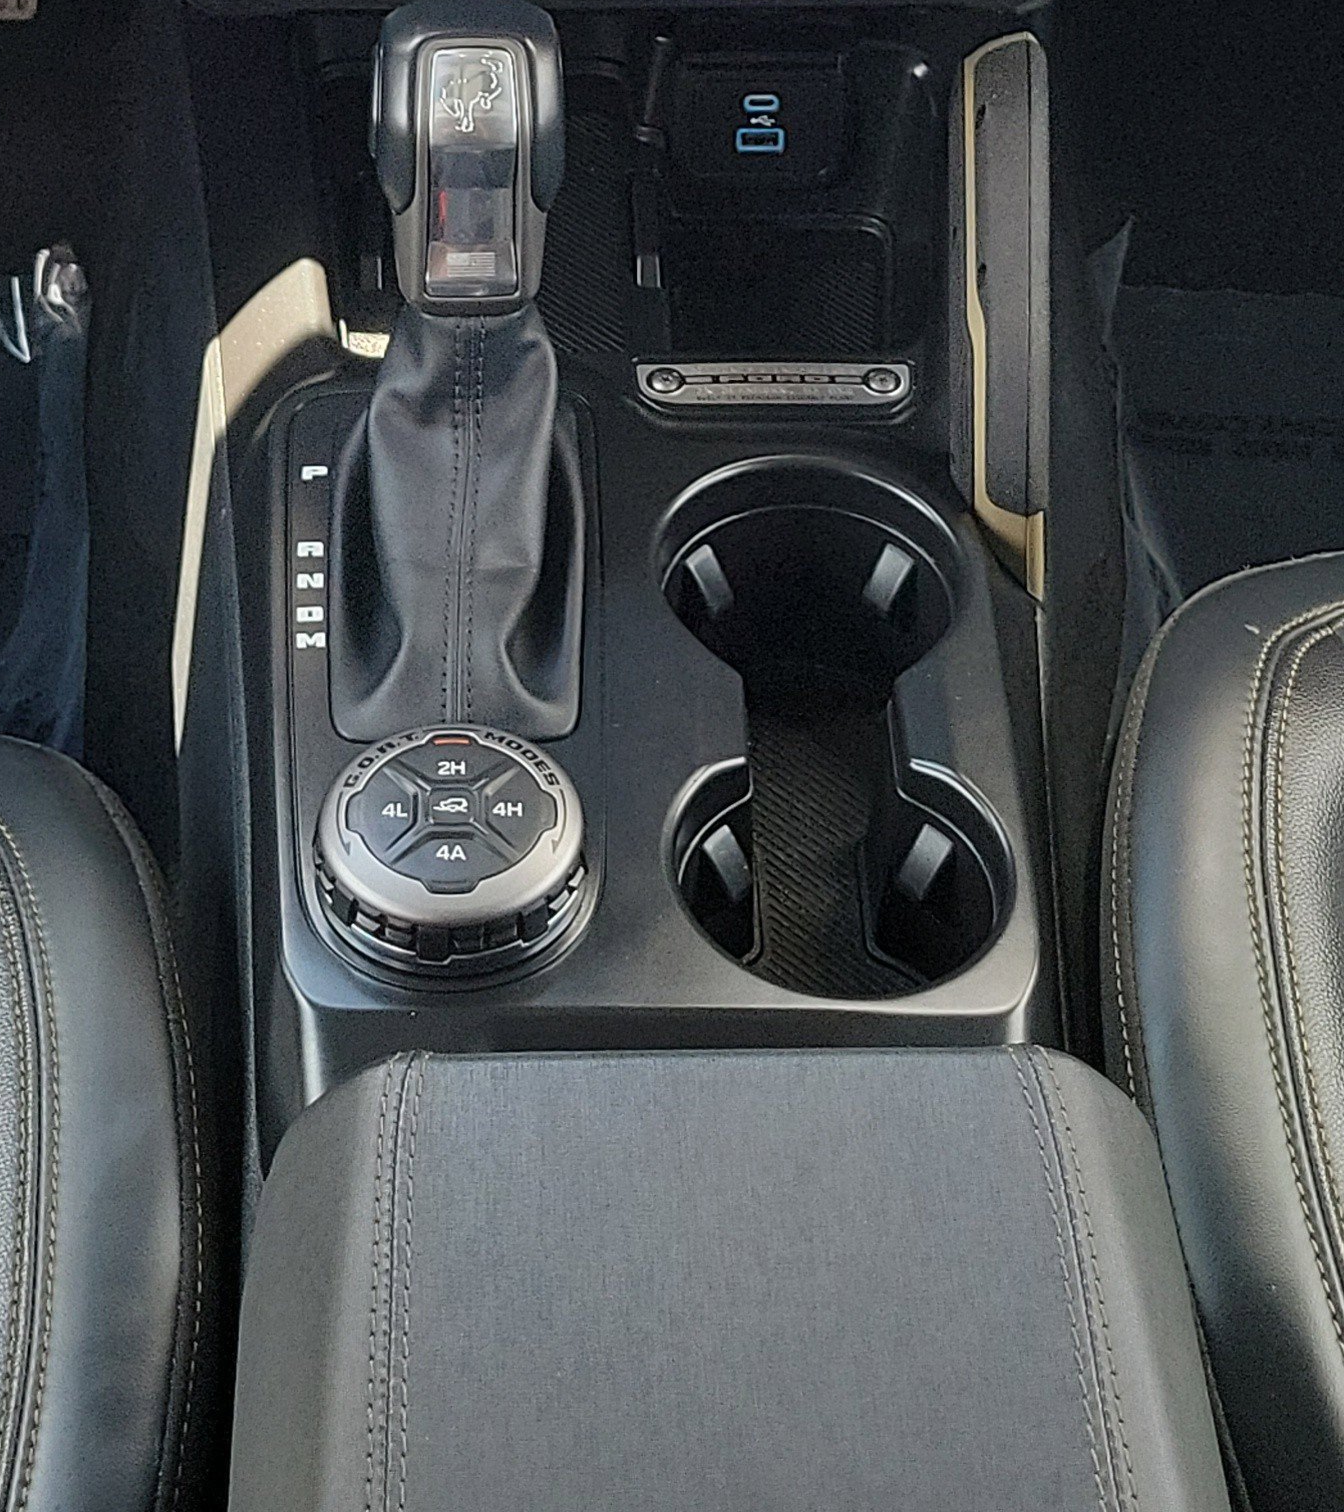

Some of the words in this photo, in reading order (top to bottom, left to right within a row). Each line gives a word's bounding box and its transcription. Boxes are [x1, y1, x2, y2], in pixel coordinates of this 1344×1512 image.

[301, 465, 328, 480] P
[297, 541, 324, 557] R
[297, 572, 324, 589] N
[296, 605, 324, 622] D
[296, 631, 326, 648] M
[484, 731, 560, 787] MODES
[437, 761, 466, 776] 2H
[381, 803, 407, 817] 4L
[492, 802, 523, 817] 4H
[436, 844, 467, 861] 4A
